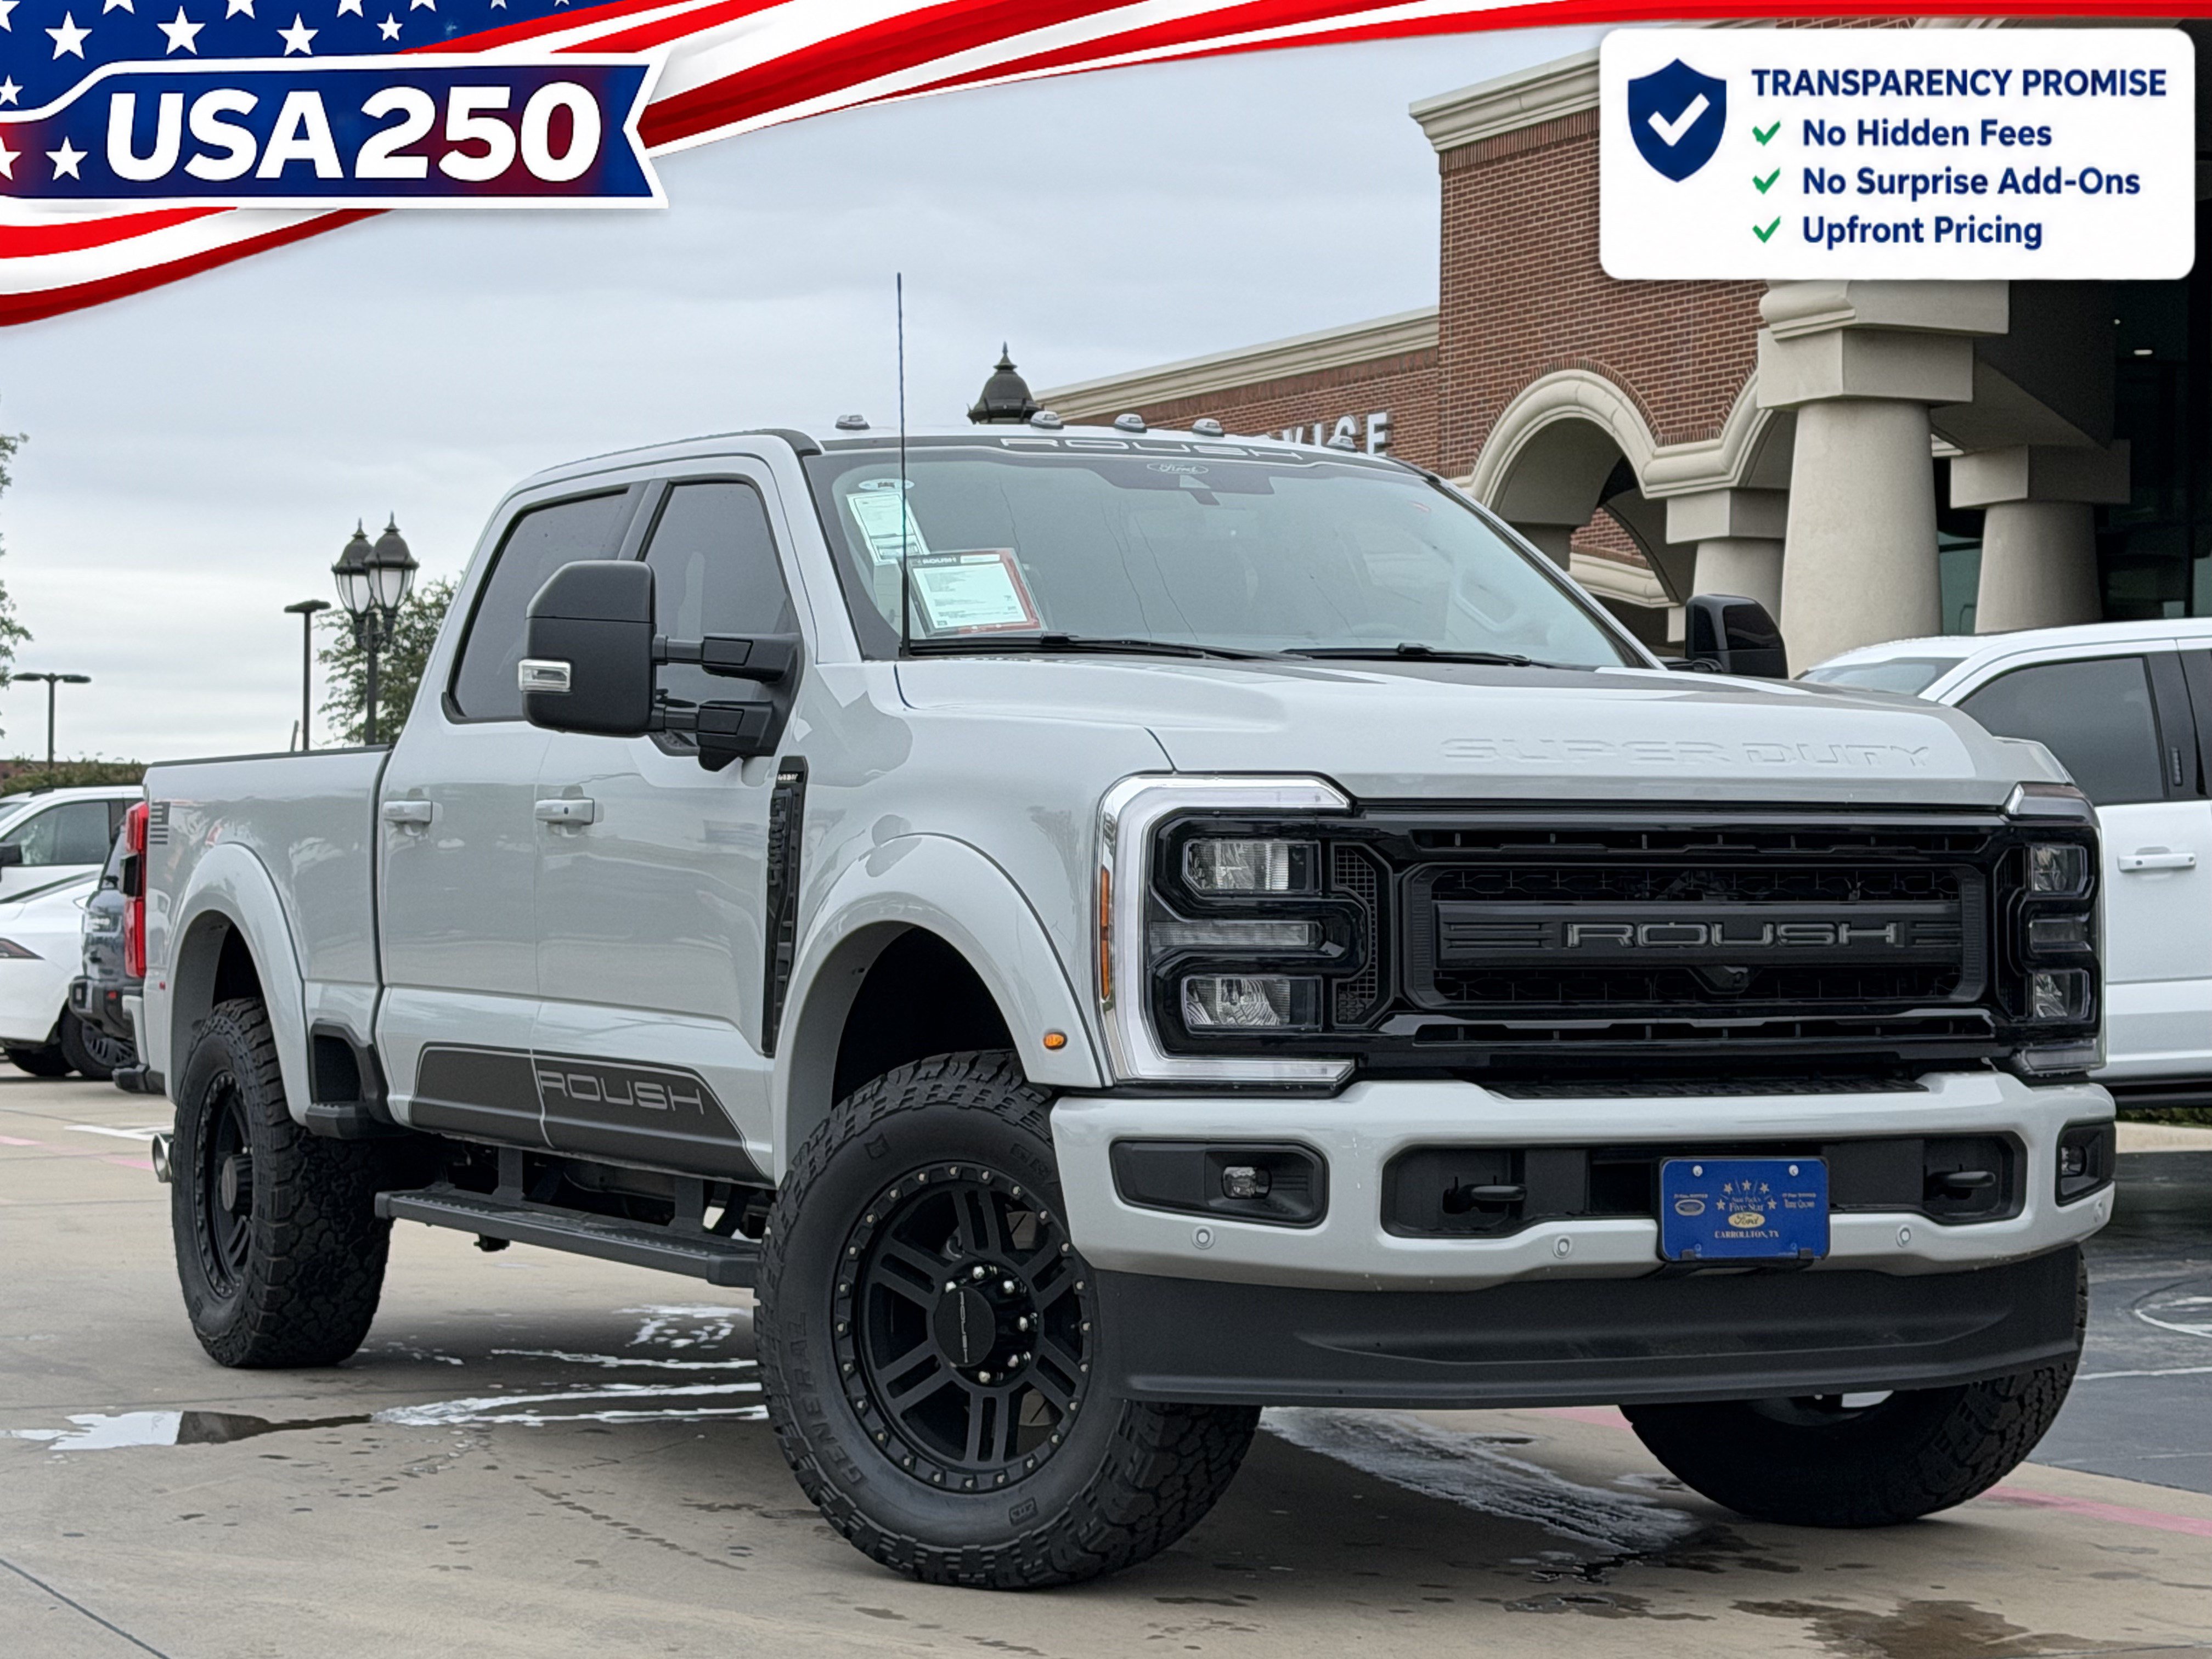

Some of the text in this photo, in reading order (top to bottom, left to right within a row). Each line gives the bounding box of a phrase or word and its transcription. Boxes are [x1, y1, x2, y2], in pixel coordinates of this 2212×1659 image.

[1000, 437, 1304, 461] ROUSH
[1440, 737, 1930, 767] SUPER DUTY
[1566, 922, 1900, 947] ROUSH
[537, 1069, 706, 1115] ROUSH
